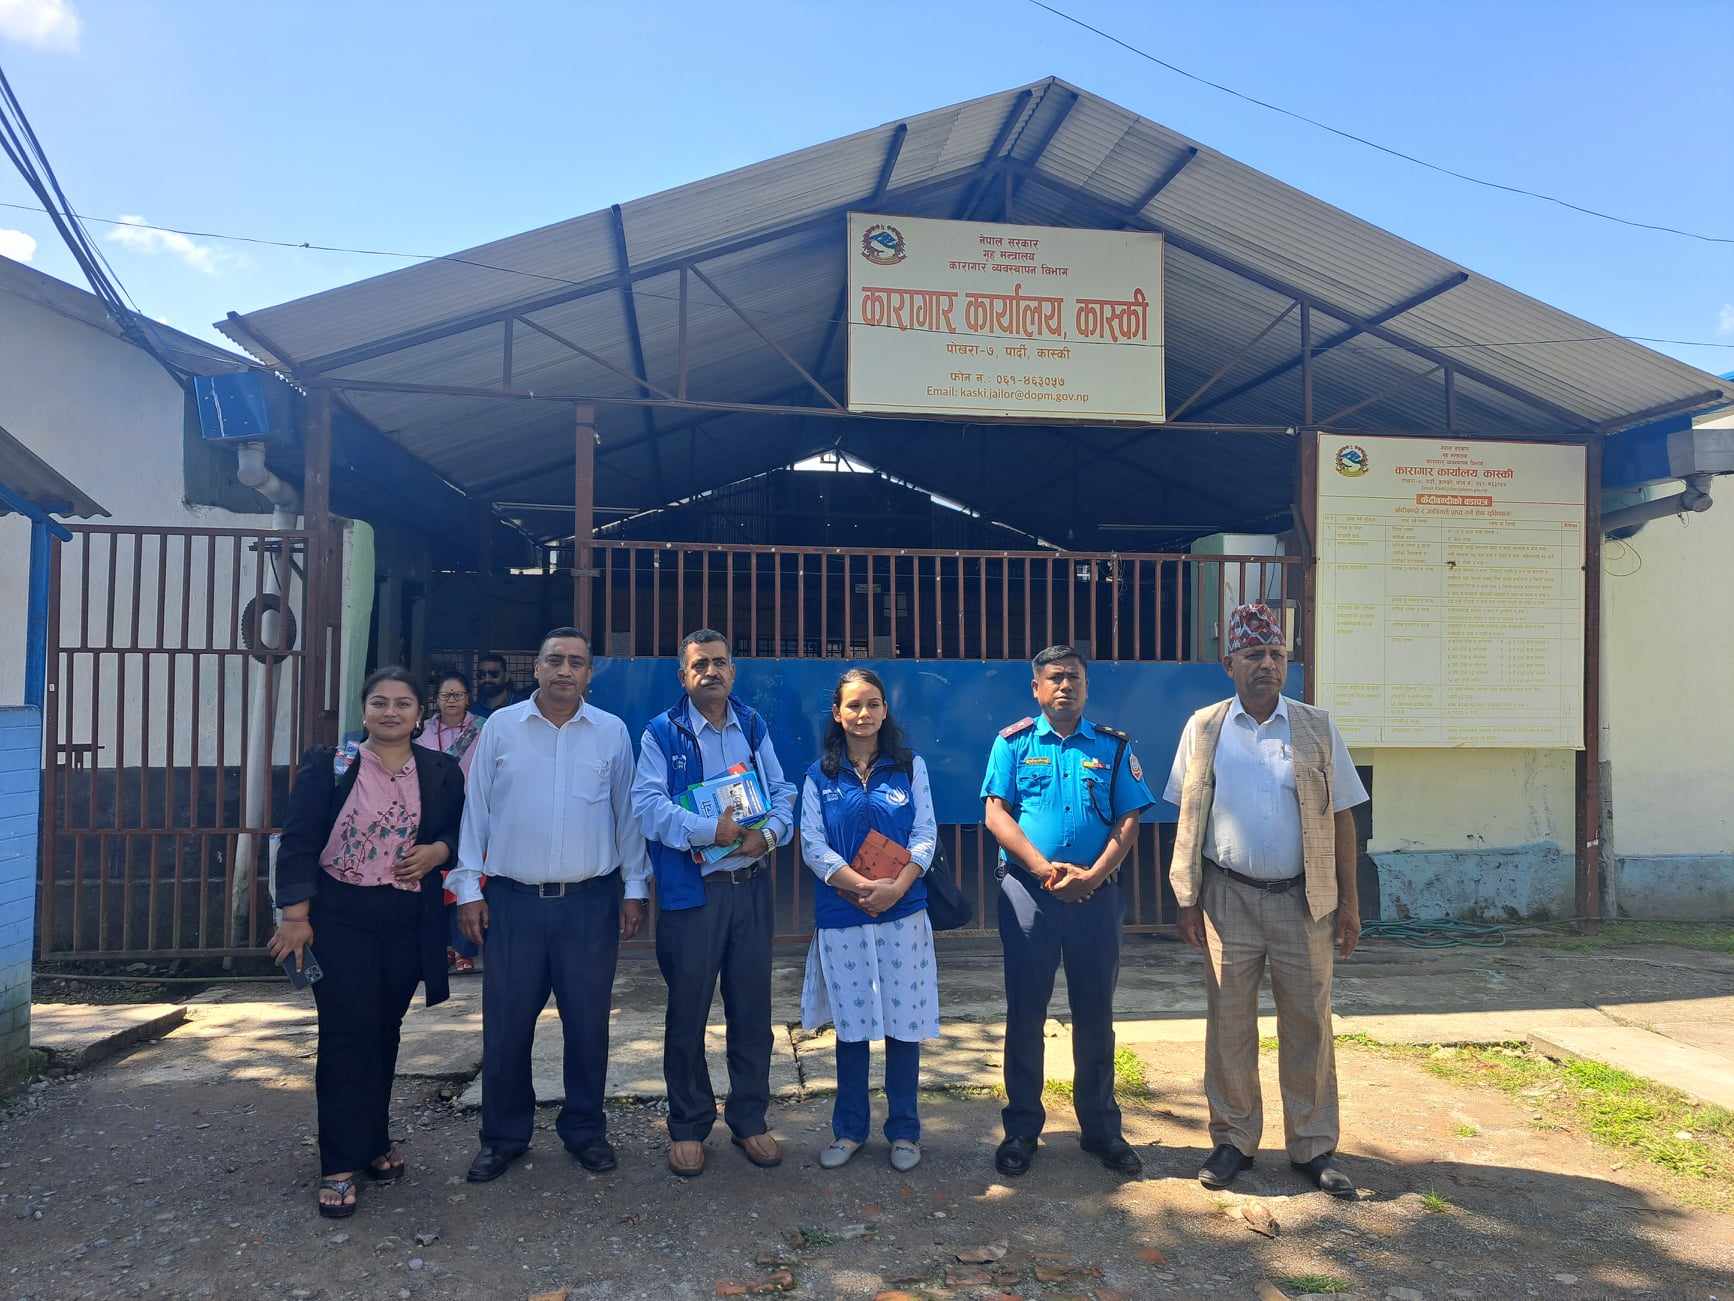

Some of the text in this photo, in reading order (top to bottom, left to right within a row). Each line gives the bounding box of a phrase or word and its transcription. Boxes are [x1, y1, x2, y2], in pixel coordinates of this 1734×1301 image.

[979, 234, 1040, 249] नेपाल सरकार
[1000, 250, 1035, 262] मन्त्रालय
[949, 261, 1069, 276] कारागार व्यवस्थापन विभाग
[862, 283, 1149, 342] कारागार कार्यालय, कास्की
[1036, 346, 1071, 360] कास्की
[950, 370, 971, 383] फोन
[927, 385, 958, 397] Email:
[1395, 466, 1434, 477] कारागार
[1483, 468, 1514, 479] कास्की
